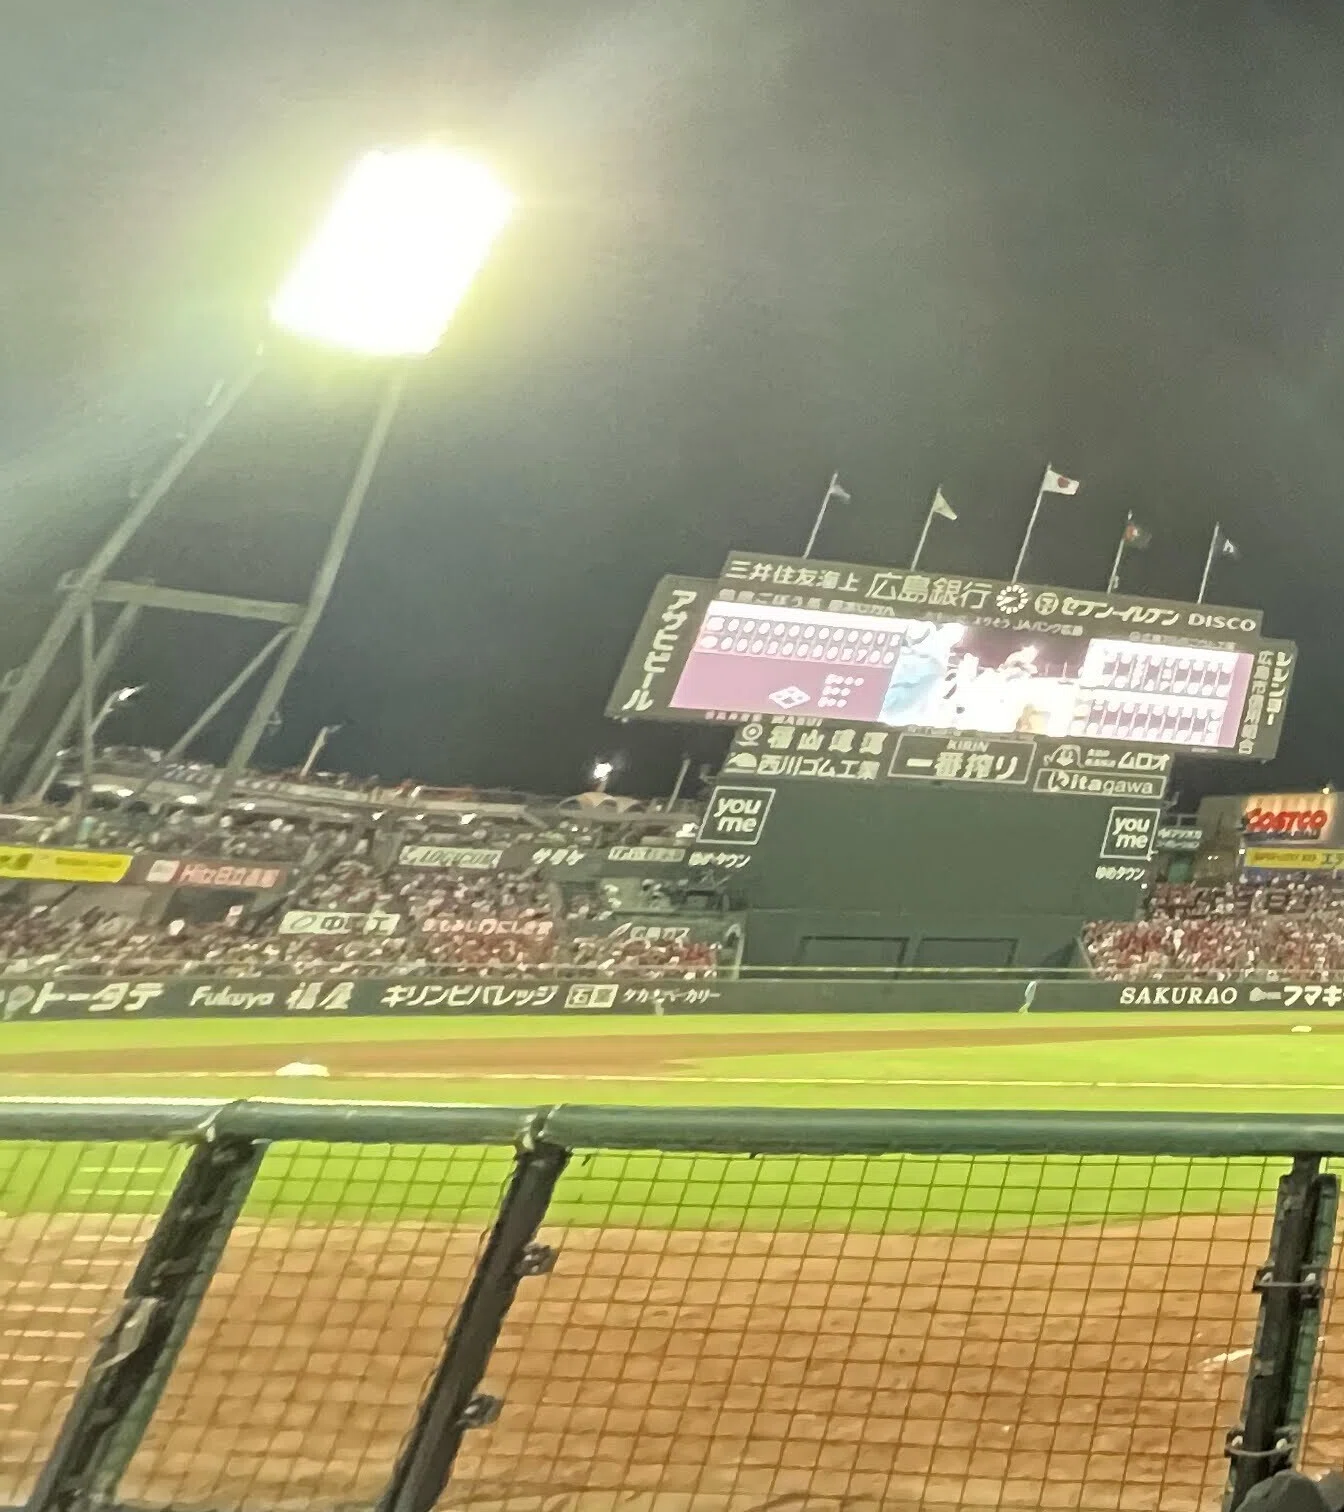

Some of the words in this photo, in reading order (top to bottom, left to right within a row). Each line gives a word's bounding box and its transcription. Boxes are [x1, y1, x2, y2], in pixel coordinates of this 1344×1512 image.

[724, 560, 861, 592] 三井住友海上
[865, 572, 994, 610] 広島銀行
[1187, 612, 1257, 632] DISCO
[621, 589, 698, 712] アサヒビール
[946, 740, 991, 753] KIRIN
[906, 751, 1018, 781] 一番搾り
[713, 797, 762, 818] you
[716, 817, 758, 833] me
[1112, 816, 1151, 836] you
[1115, 834, 1149, 849] me
[30, 982, 165, 1014] トータテ
[190, 986, 275, 1010] Fukuya
[380, 984, 559, 1008] キリンビバレッジ
[1119, 986, 1238, 1005] SAKURAO
